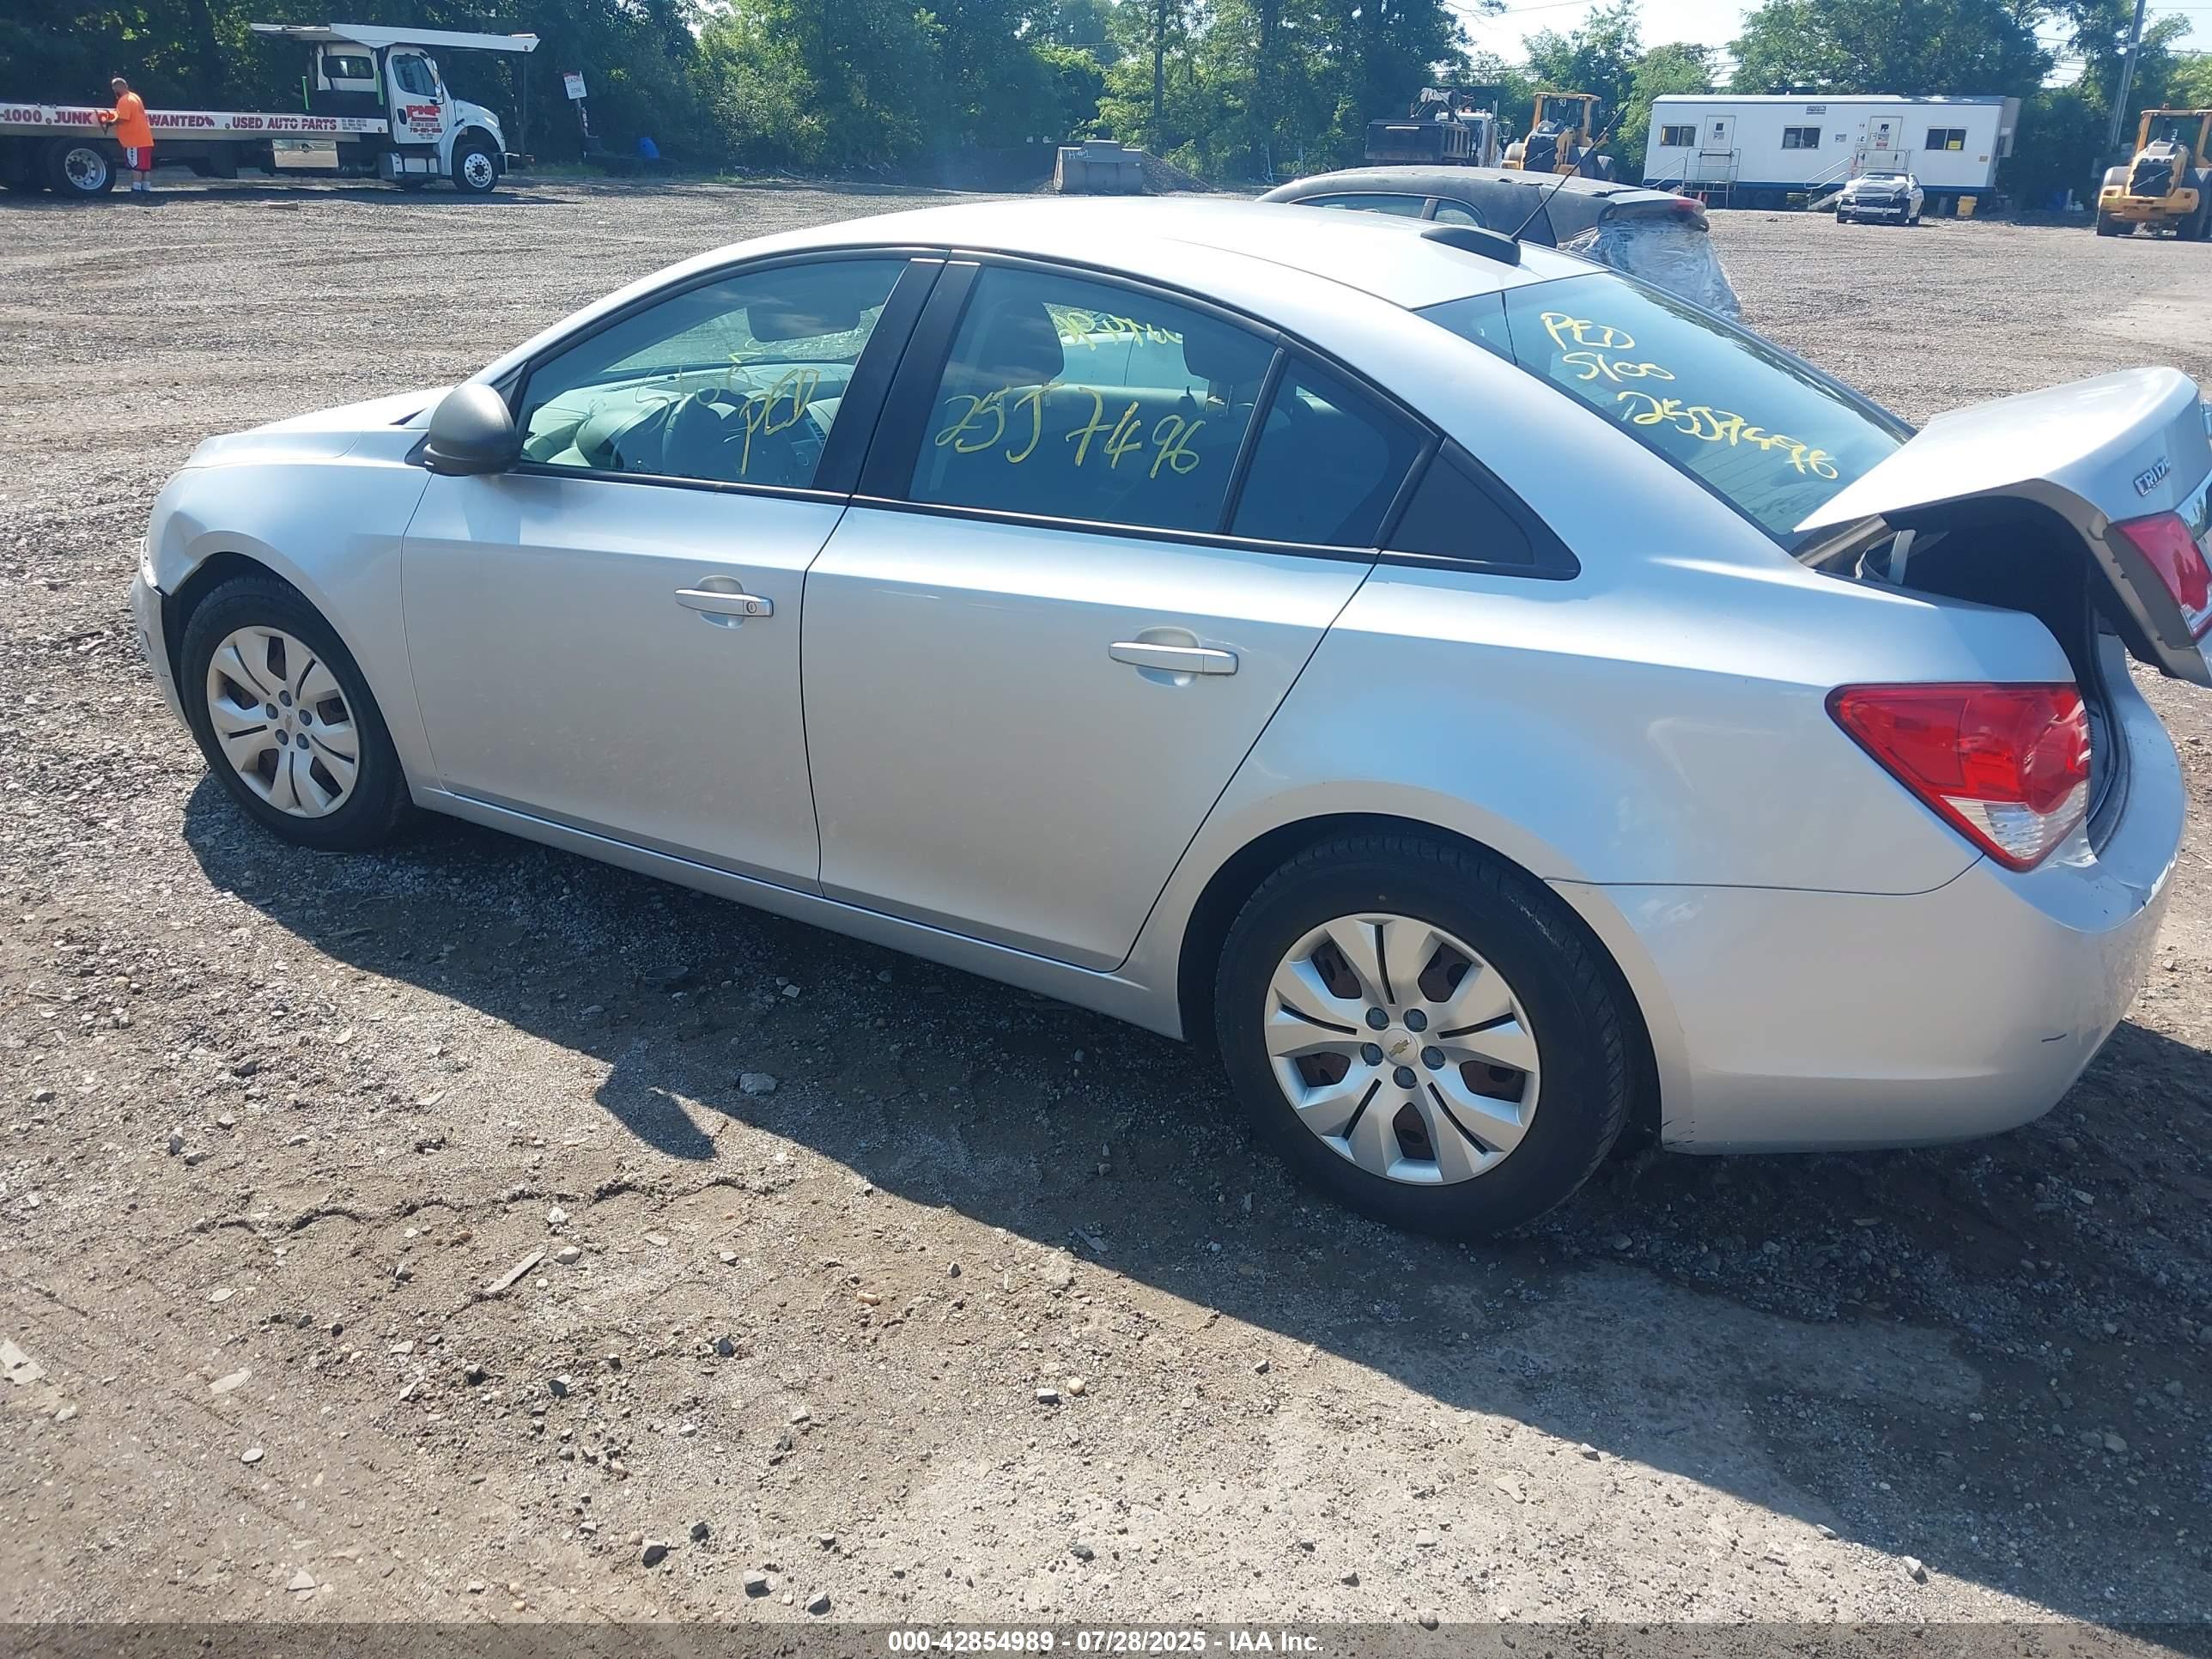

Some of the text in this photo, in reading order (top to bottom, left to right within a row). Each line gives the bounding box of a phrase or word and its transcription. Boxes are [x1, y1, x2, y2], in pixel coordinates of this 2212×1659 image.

[1559, 98, 1567, 107] 93
[54, 111, 92, 124] JUNK
[148, 115, 204, 127] WANTED
[232, 116, 263, 129] USED
[267, 117, 298, 130] AUTO
[301, 118, 337, 131] PARTS
[1540, 312, 1635, 350] PED
